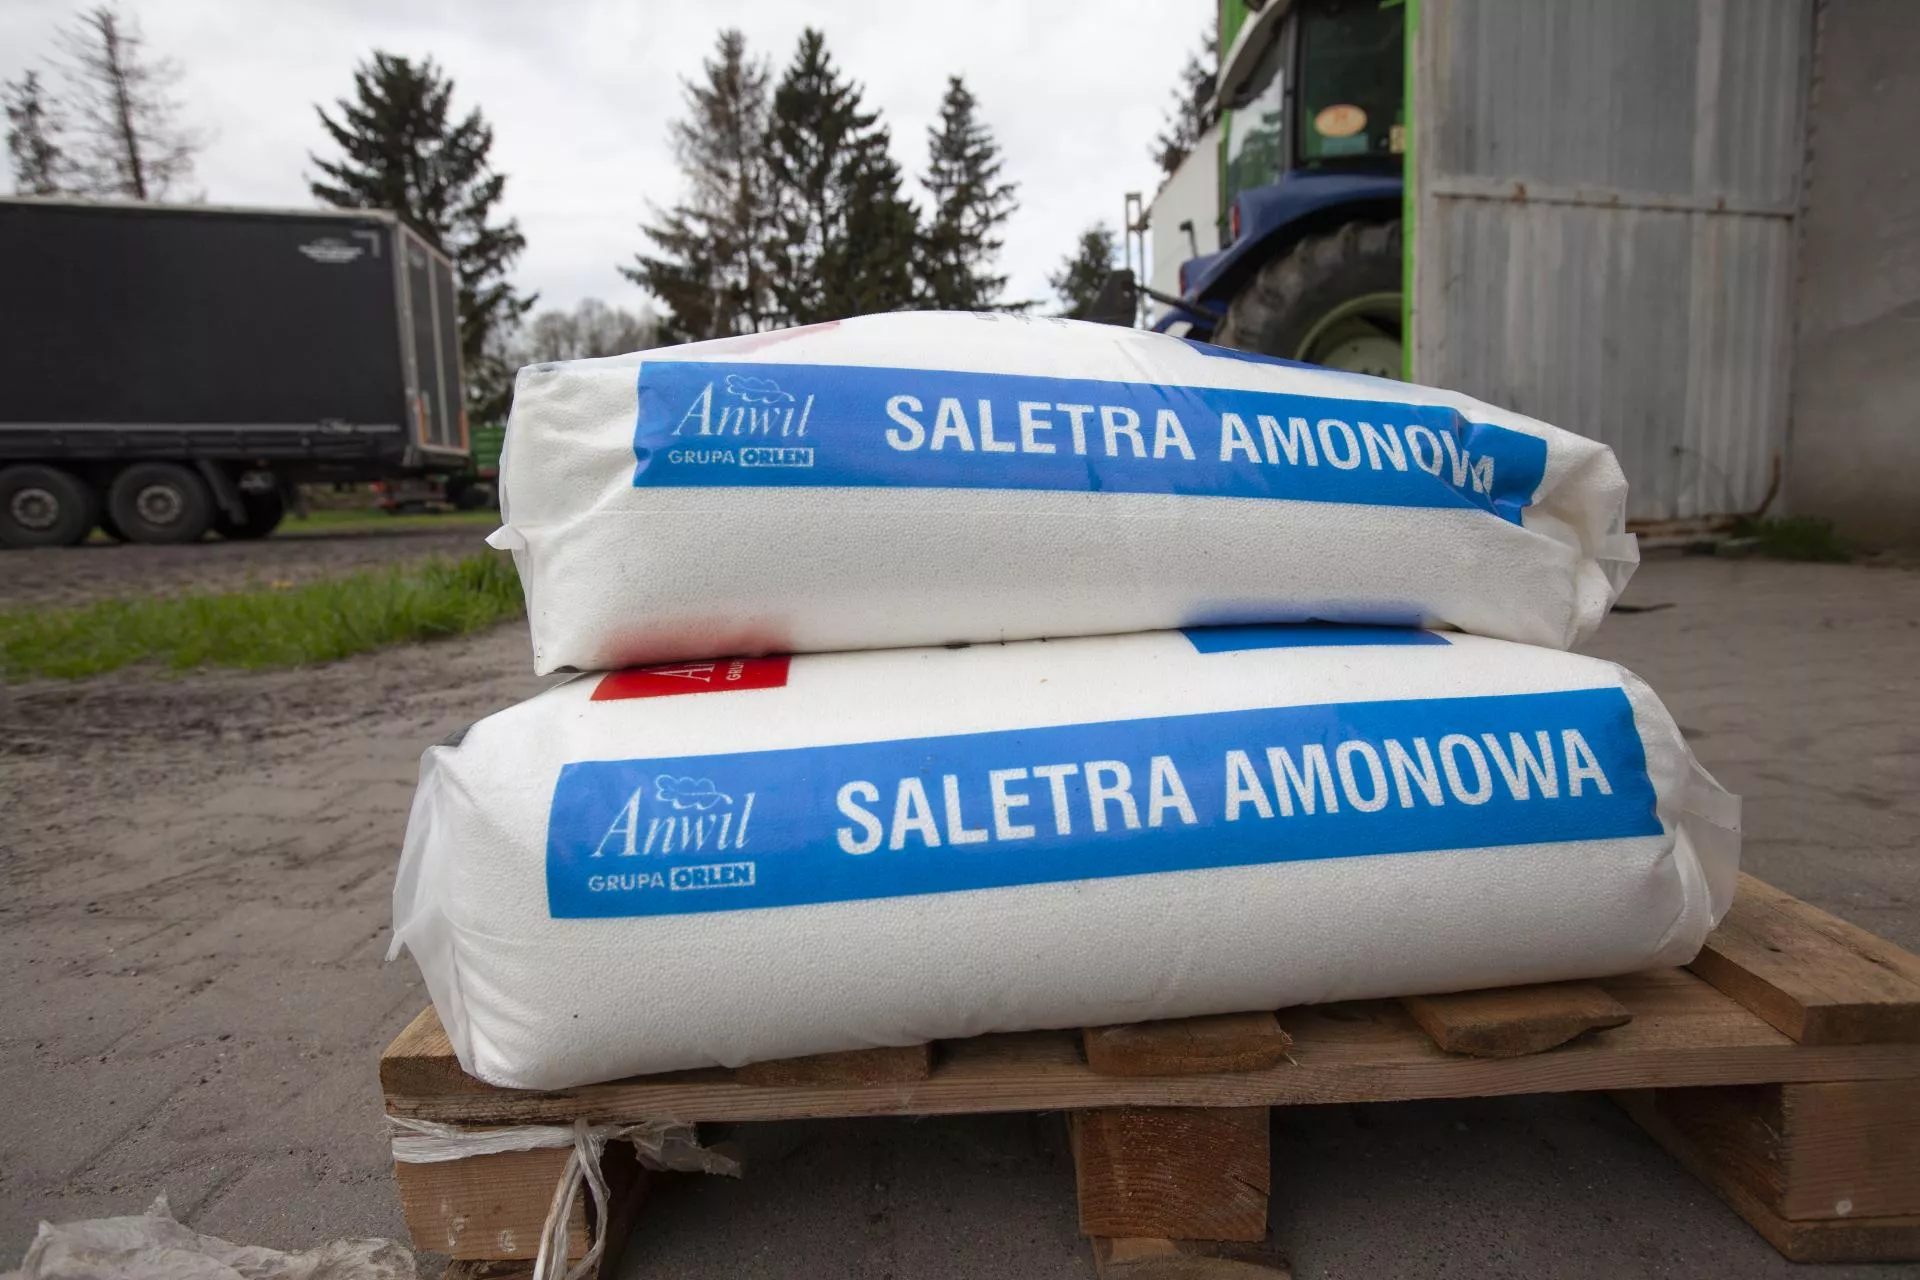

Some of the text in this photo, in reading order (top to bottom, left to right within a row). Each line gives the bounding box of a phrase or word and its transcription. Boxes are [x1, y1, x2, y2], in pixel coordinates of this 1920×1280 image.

[671, 382, 815, 437] Anwil
[885, 394, 1197, 461] SALETRA
[668, 448, 814, 467] GRUPA ORLEN
[591, 787, 756, 857] Anwil
[836, 729, 1612, 855] SALETRA AMONOWA
[588, 862, 755, 892] GRUPA ORLEN
